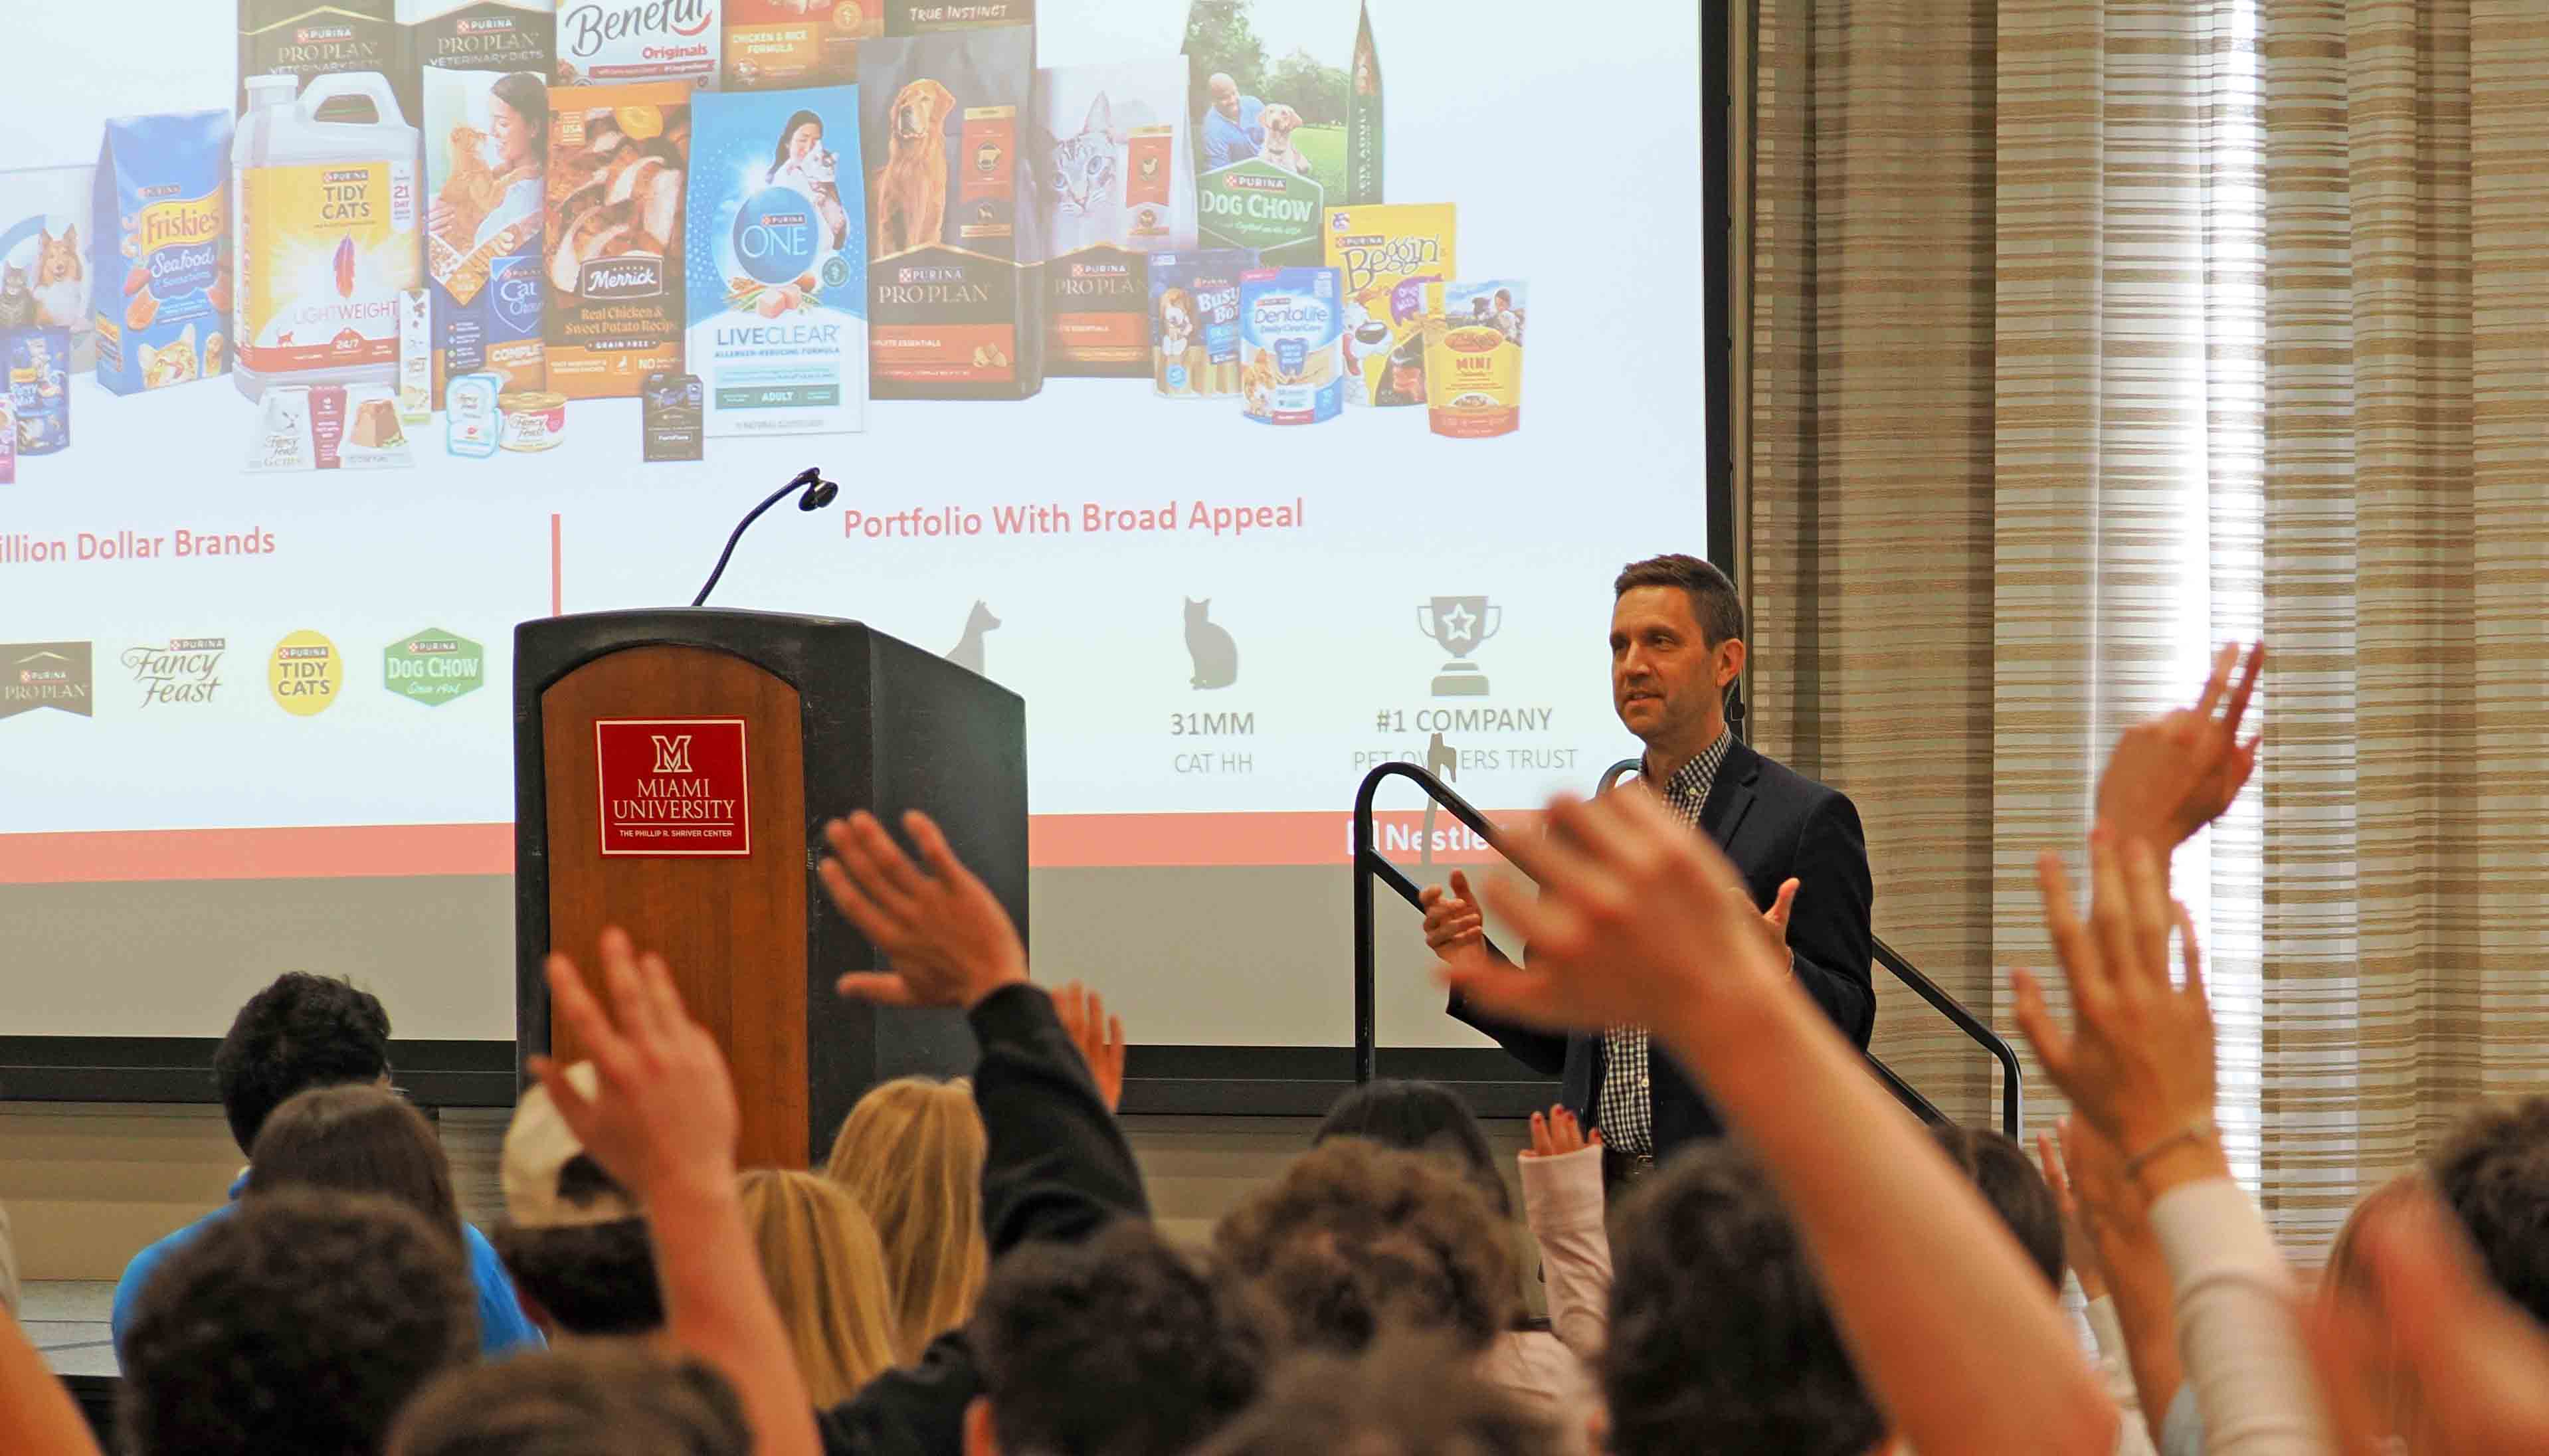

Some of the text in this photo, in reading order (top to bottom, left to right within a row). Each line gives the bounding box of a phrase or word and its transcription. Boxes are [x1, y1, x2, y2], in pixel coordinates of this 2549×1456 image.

[909, 5, 1006, 21] TRUE INSTINCT
[310, 28, 351, 39] PURINA
[470, 19, 512, 30] PURINA
[278, 45, 320, 63] PRO
[436, 36, 479, 54] PRO
[642, 43, 708, 61] Originals
[1238, 175, 1285, 188] PURINA
[323, 185, 367, 203] TIDY
[322, 201, 371, 220] CATS
[1200, 190, 1313, 222] DOG CHOW
[147, 208, 220, 244] Friskies
[741, 224, 808, 258] ONE
[151, 246, 215, 278] Seafood
[587, 268, 657, 292] Merrick
[912, 270, 963, 282] PURINA
[500, 280, 537, 302] Cat
[878, 283, 989, 304] PRO PLAN
[1054, 277, 1093, 296] PRO
[581, 308, 606, 320] Real
[608, 305, 652, 320] Chicken
[717, 324, 837, 347] LIVECLEAR
[1456, 357, 1491, 371] MINI
[844, 497, 1303, 538] Portfolio With Broad Appeal
[77, 530, 165, 561] Dollar
[174, 526, 276, 557] Brands
[182, 640, 225, 650] PURINA
[289, 647, 327, 657] PURINA
[419, 642, 456, 651] PURINA
[120, 647, 225, 681] Fancy
[278, 662, 328, 679] TIDY
[387, 656, 480, 680] DOG CHOW
[31, 671, 66, 680] PURINA
[5, 683, 86, 700] PRO PLAN
[138, 675, 224, 709] Feast
[278, 679, 331, 696] CATS
[1171, 713, 1254, 735] 31MM
[1376, 707, 1553, 733] #1 COMPANY
[1175, 752, 1253, 774] CAT HH
[1400, 749, 1500, 771] OERS
[1506, 747, 1578, 771] TRUST
[637, 778, 711, 798] MIAMI
[613, 798, 736, 820] UNIVERSITY
[619, 829, 634, 838] THE
[634, 829, 662, 838] PHILLIP
[671, 829, 702, 838] SHRIVER
[703, 829, 733, 838] CENTER
